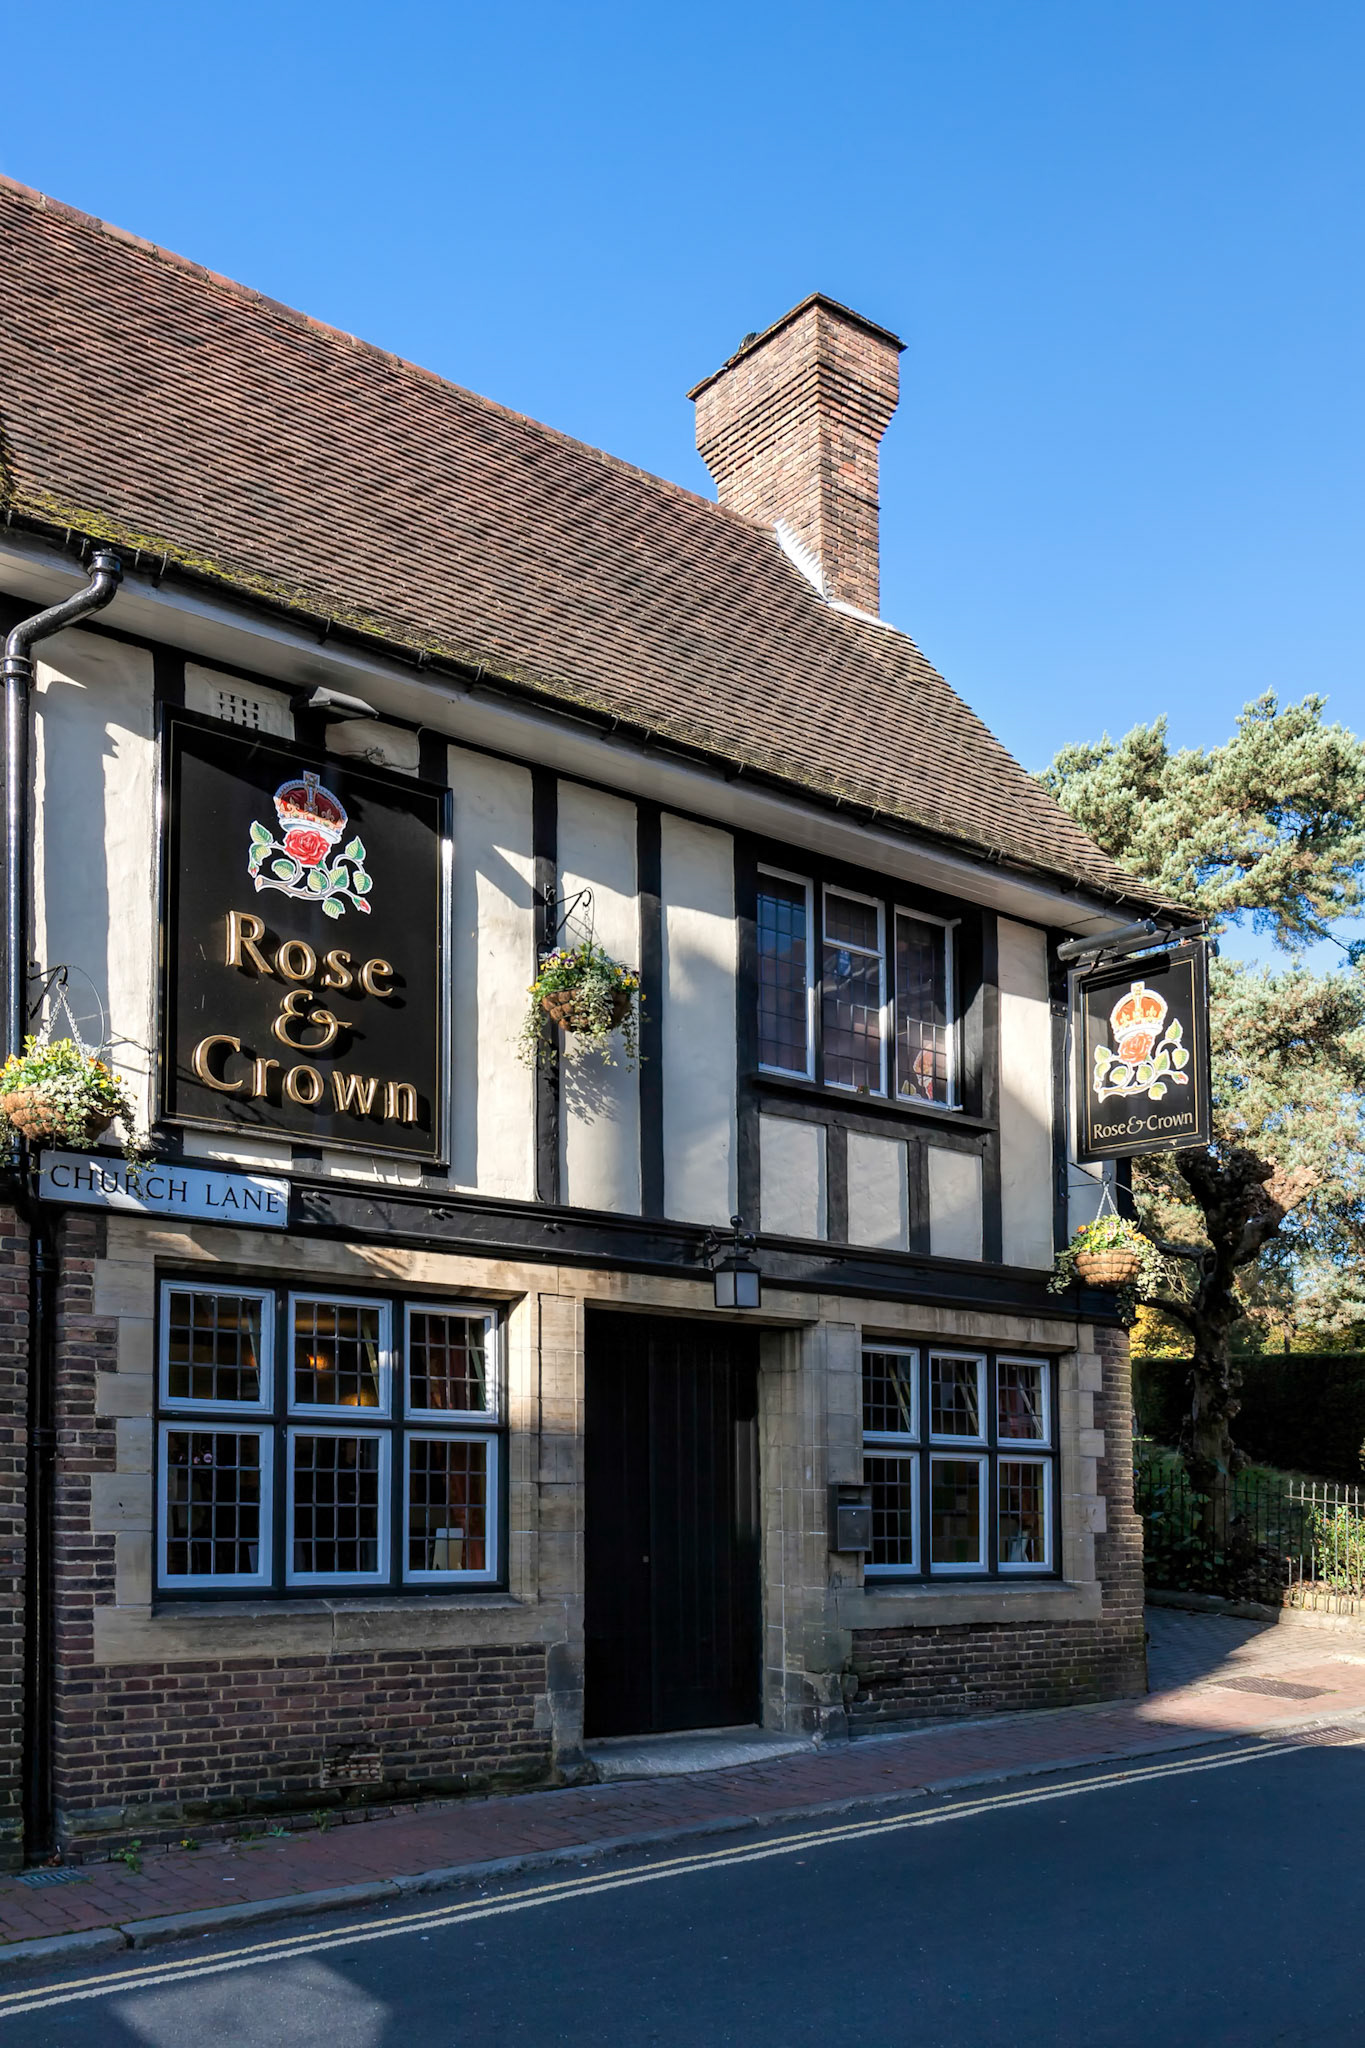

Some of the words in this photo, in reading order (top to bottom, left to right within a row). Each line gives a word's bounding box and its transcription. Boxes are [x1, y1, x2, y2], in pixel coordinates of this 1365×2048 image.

[225, 910, 394, 997] Rose
[271, 989, 353, 1049] &
[191, 1034, 418, 1122] Crown
[1093, 1123, 1126, 1140] Rose
[1146, 1111, 1193, 1131] Crown
[50, 1165, 187, 1203] CHURCH
[205, 1183, 280, 1214] LANE
